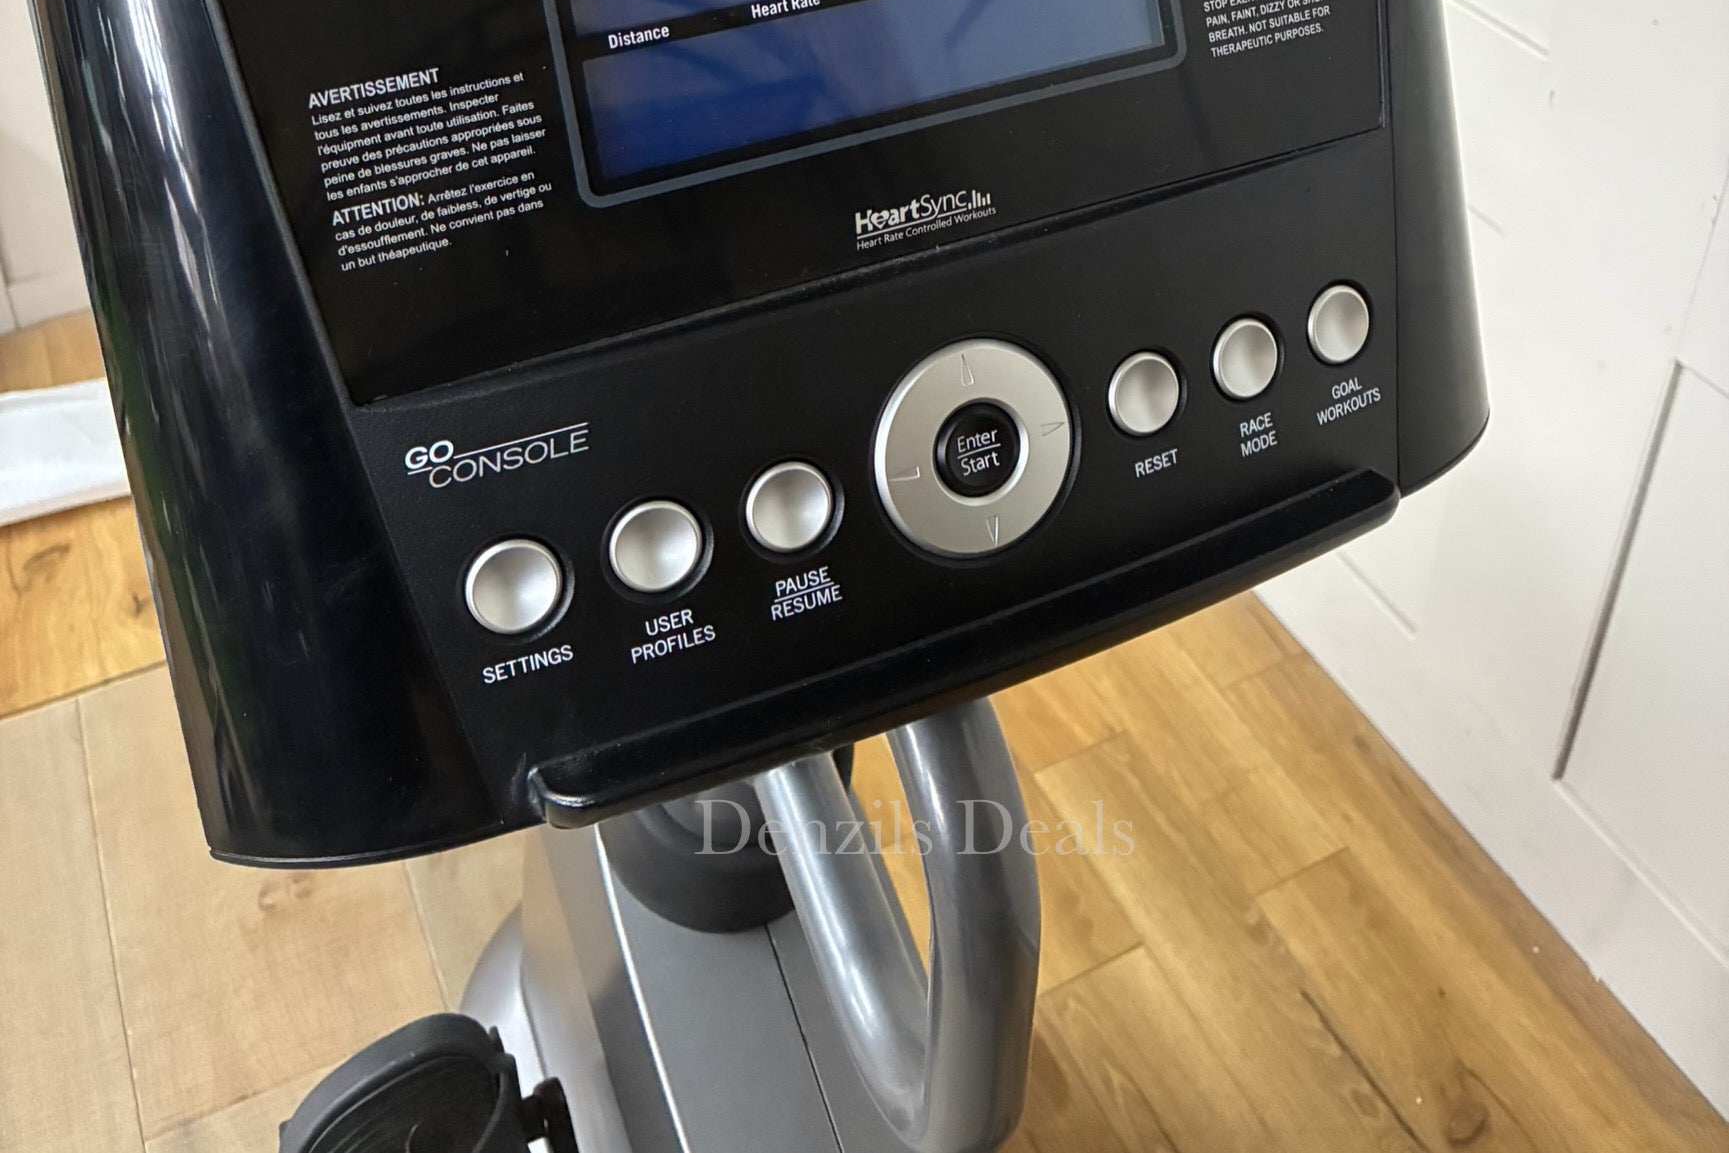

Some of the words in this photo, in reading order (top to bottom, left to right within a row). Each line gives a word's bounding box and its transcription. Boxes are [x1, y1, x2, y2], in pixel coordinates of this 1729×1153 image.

[1248, 19, 1267, 33] NOT
[1268, 9, 1311, 29] SUITABLE
[1311, 5, 1331, 19] FOR
[1259, 0, 1285, 15] DIZZY
[607, 26, 670, 49] Distance
[1210, 33, 1273, 58] THERAPEUTIC
[308, 67, 439, 109] AVERTISSEMENT
[311, 112, 343, 126] Lisez
[343, 107, 356, 119] et
[357, 101, 394, 116] suivez
[394, 93, 430, 108] toutes
[430, 89, 448, 100] les
[449, 76, 512, 97] instructions
[512, 71, 524, 83] et
[314, 128, 340, 141] tous
[340, 124, 359, 135] les
[448, 93, 499, 112] Inspecter
[383, 126, 415, 142] avant
[415, 121, 444, 135] toute
[501, 101, 535, 116] Faites
[320, 155, 360, 174] preuve
[361, 150, 383, 162] des
[384, 135, 450, 159] précautions
[516, 114, 543, 128] sous
[323, 172, 356, 189] peine
[357, 167, 372, 179] de
[373, 155, 428, 175] blessures
[471, 141, 488, 153] Ne
[489, 137, 510, 151] pas
[511, 128, 546, 144] laisser
[326, 190, 345, 201] les
[346, 180, 388, 197] enfants
[454, 161, 470, 172] de
[471, 155, 489, 168] cet
[427, 187, 468, 205] Arrêtez
[520, 171, 535, 182] en
[334, 229, 356, 242] cas
[357, 224, 373, 236] de
[420, 210, 435, 221] de
[483, 195, 498, 206] de
[499, 186, 537, 202] vertige
[538, 183, 552, 193] ou
[430, 223, 447, 234] Ne
[448, 210, 495, 230] convient
[495, 206, 516, 221] pas
[517, 200, 544, 213] dans
[856, 236, 882, 251] Heart
[883, 231, 904, 243] Rate
[905, 217, 953, 237] Controlled
[953, 207, 997, 224] Workouts
[341, 260, 356, 272] un
[357, 254, 377, 268] but
[1331, 376, 1363, 400] GOAL
[1316, 387, 1381, 426] WORKOUTS
[957, 429, 998, 453] Enter
[1239, 412, 1273, 438] RACE
[405, 439, 454, 470] GO
[428, 429, 590, 489] CONSOLE
[1240, 430, 1278, 457] MODE
[960, 451, 1000, 476] Start
[1134, 448, 1178, 478] RESET
[775, 566, 831, 597] PAUSE
[770, 584, 843, 621] RESUME
[645, 608, 694, 636] USER
[630, 624, 716, 664] PROFILES
[482, 644, 574, 684] SETTINGS
